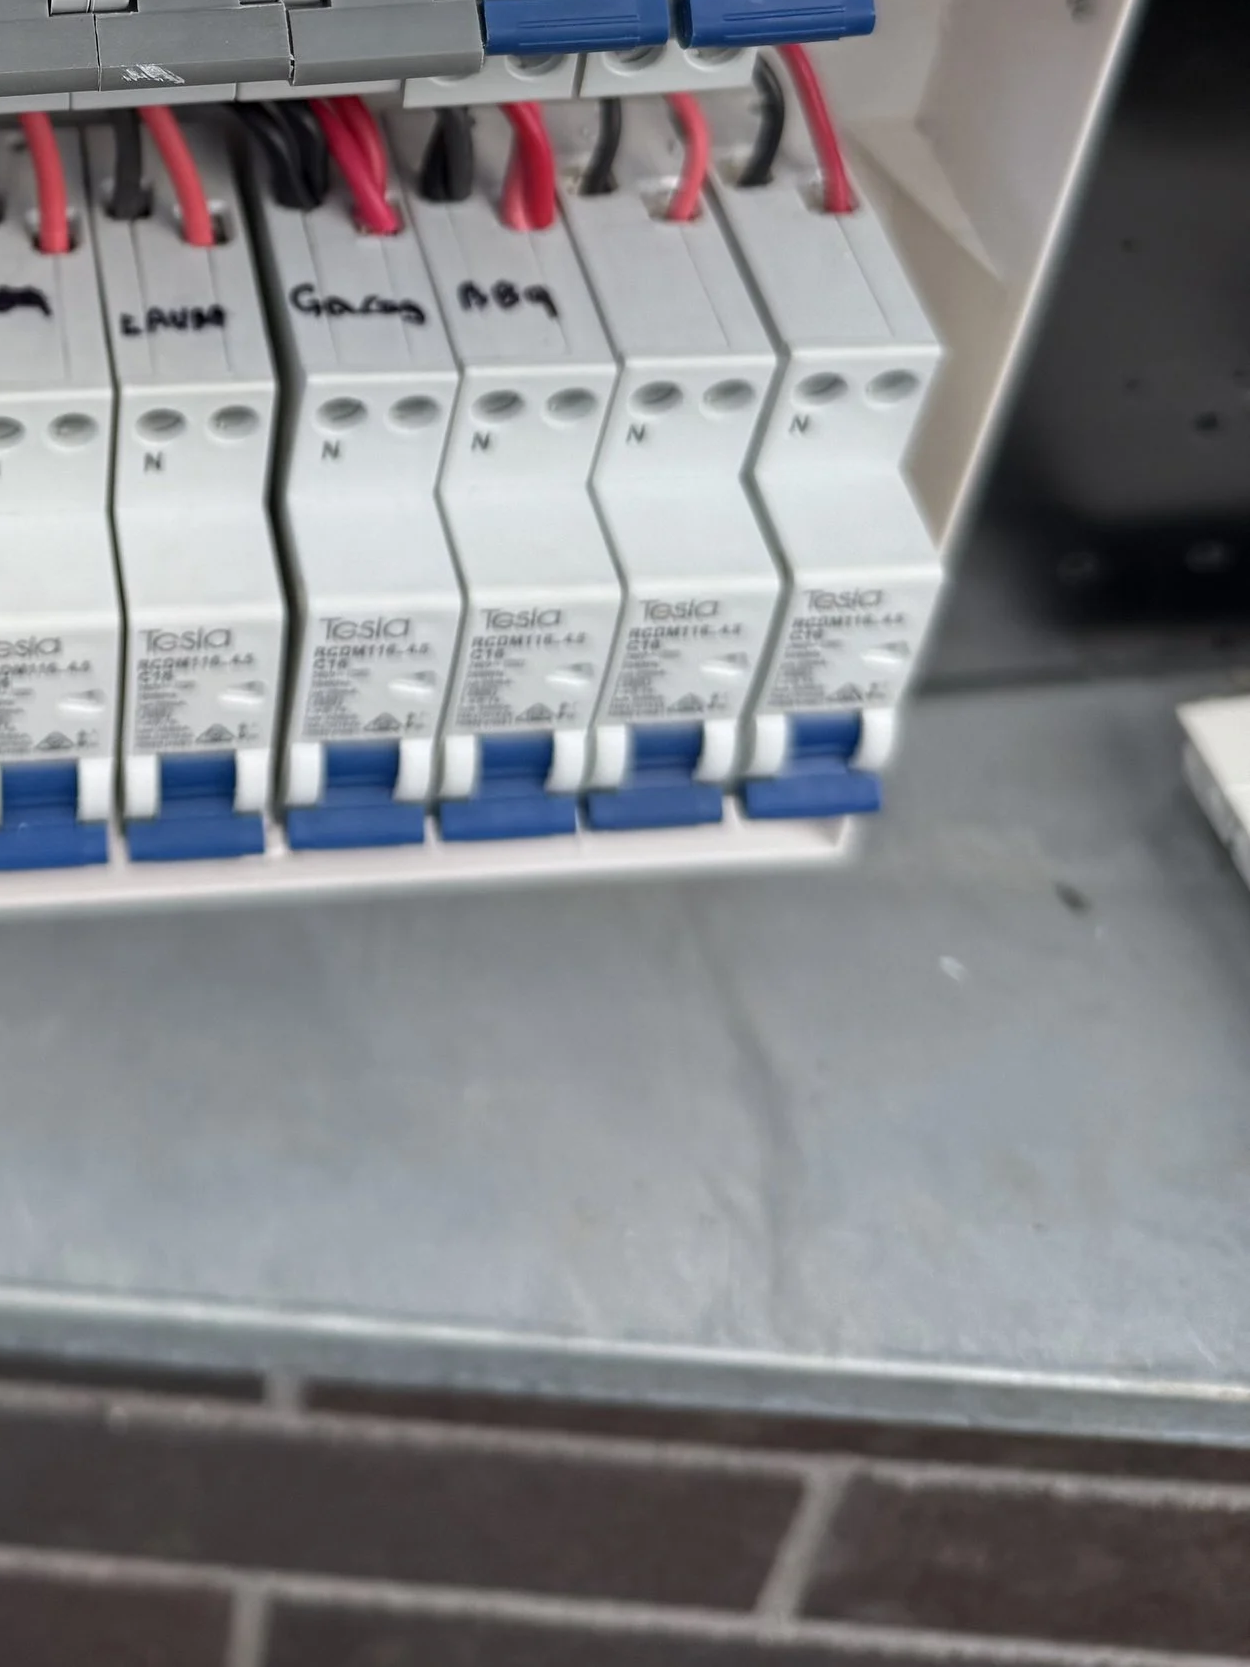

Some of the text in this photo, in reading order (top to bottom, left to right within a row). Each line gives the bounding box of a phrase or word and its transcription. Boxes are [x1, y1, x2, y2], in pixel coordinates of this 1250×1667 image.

[626, 423, 647, 443] N
[789, 414, 810, 434] N
[322, 440, 342, 460] N
[471, 432, 491, 452] N
[144, 452, 164, 471] N
